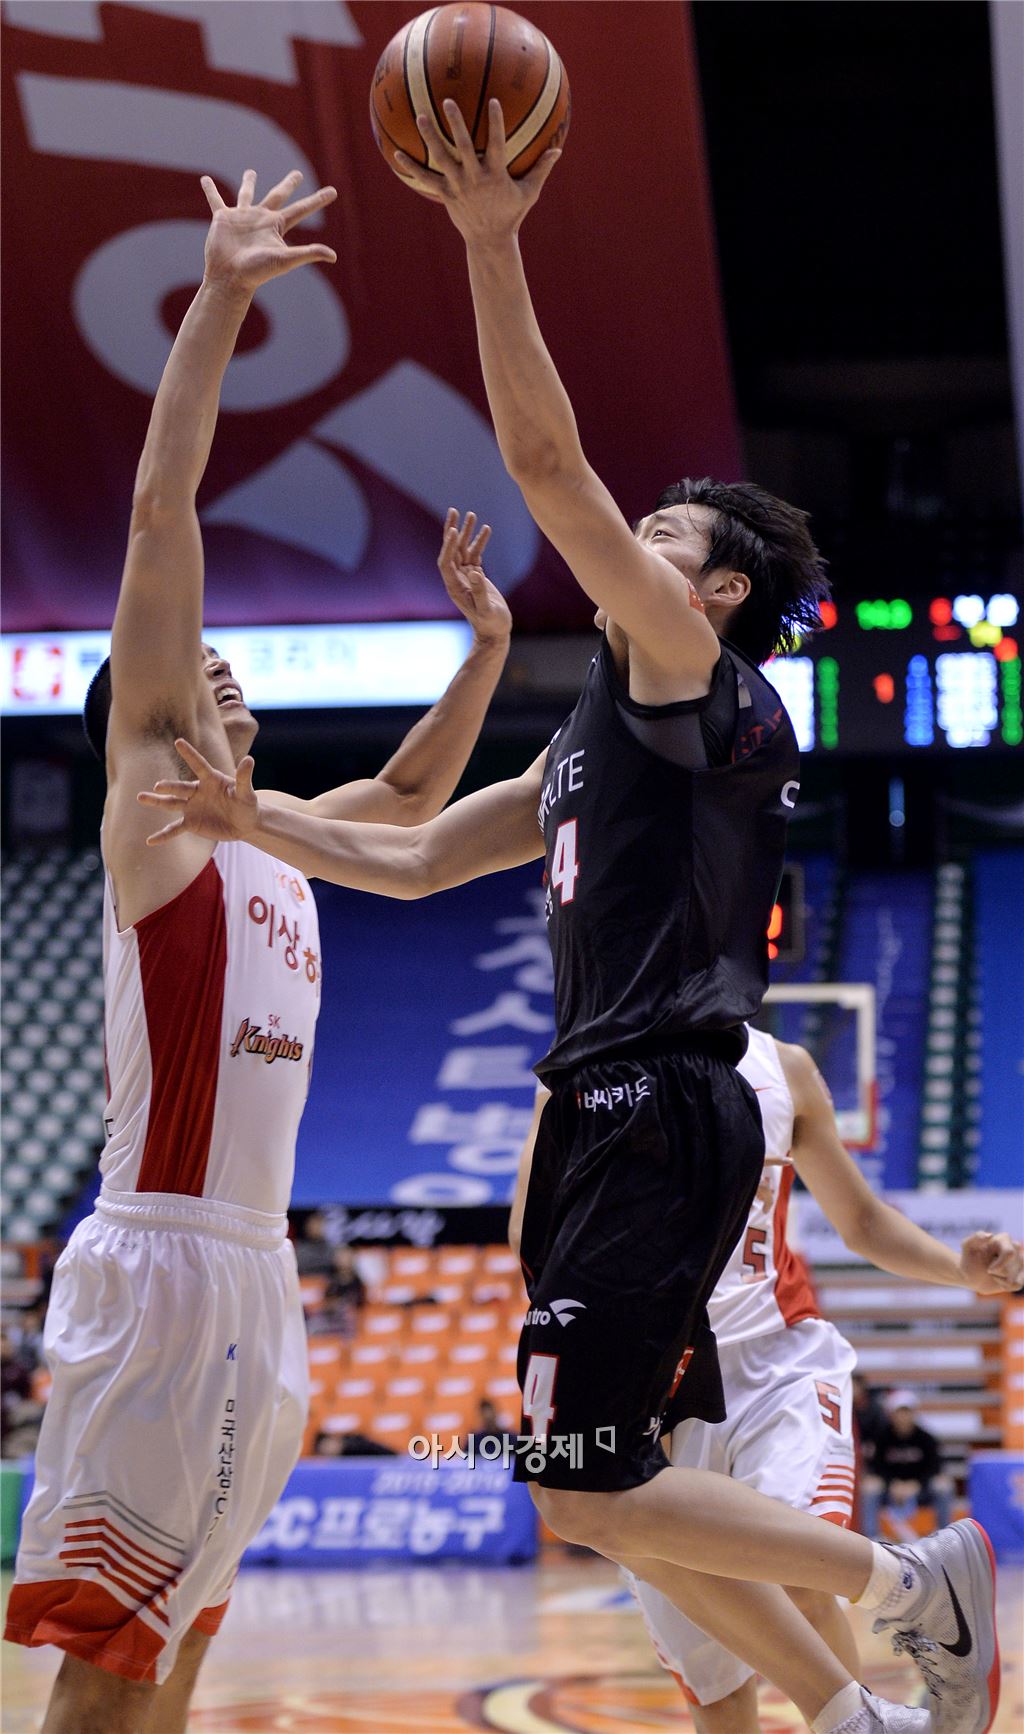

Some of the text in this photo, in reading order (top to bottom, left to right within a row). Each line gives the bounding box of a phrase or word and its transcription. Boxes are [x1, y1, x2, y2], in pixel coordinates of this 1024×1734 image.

[230, 1017, 304, 1064] Knights
[268, 1014, 281, 1028] SK
[816, 1381, 842, 1435] 5
